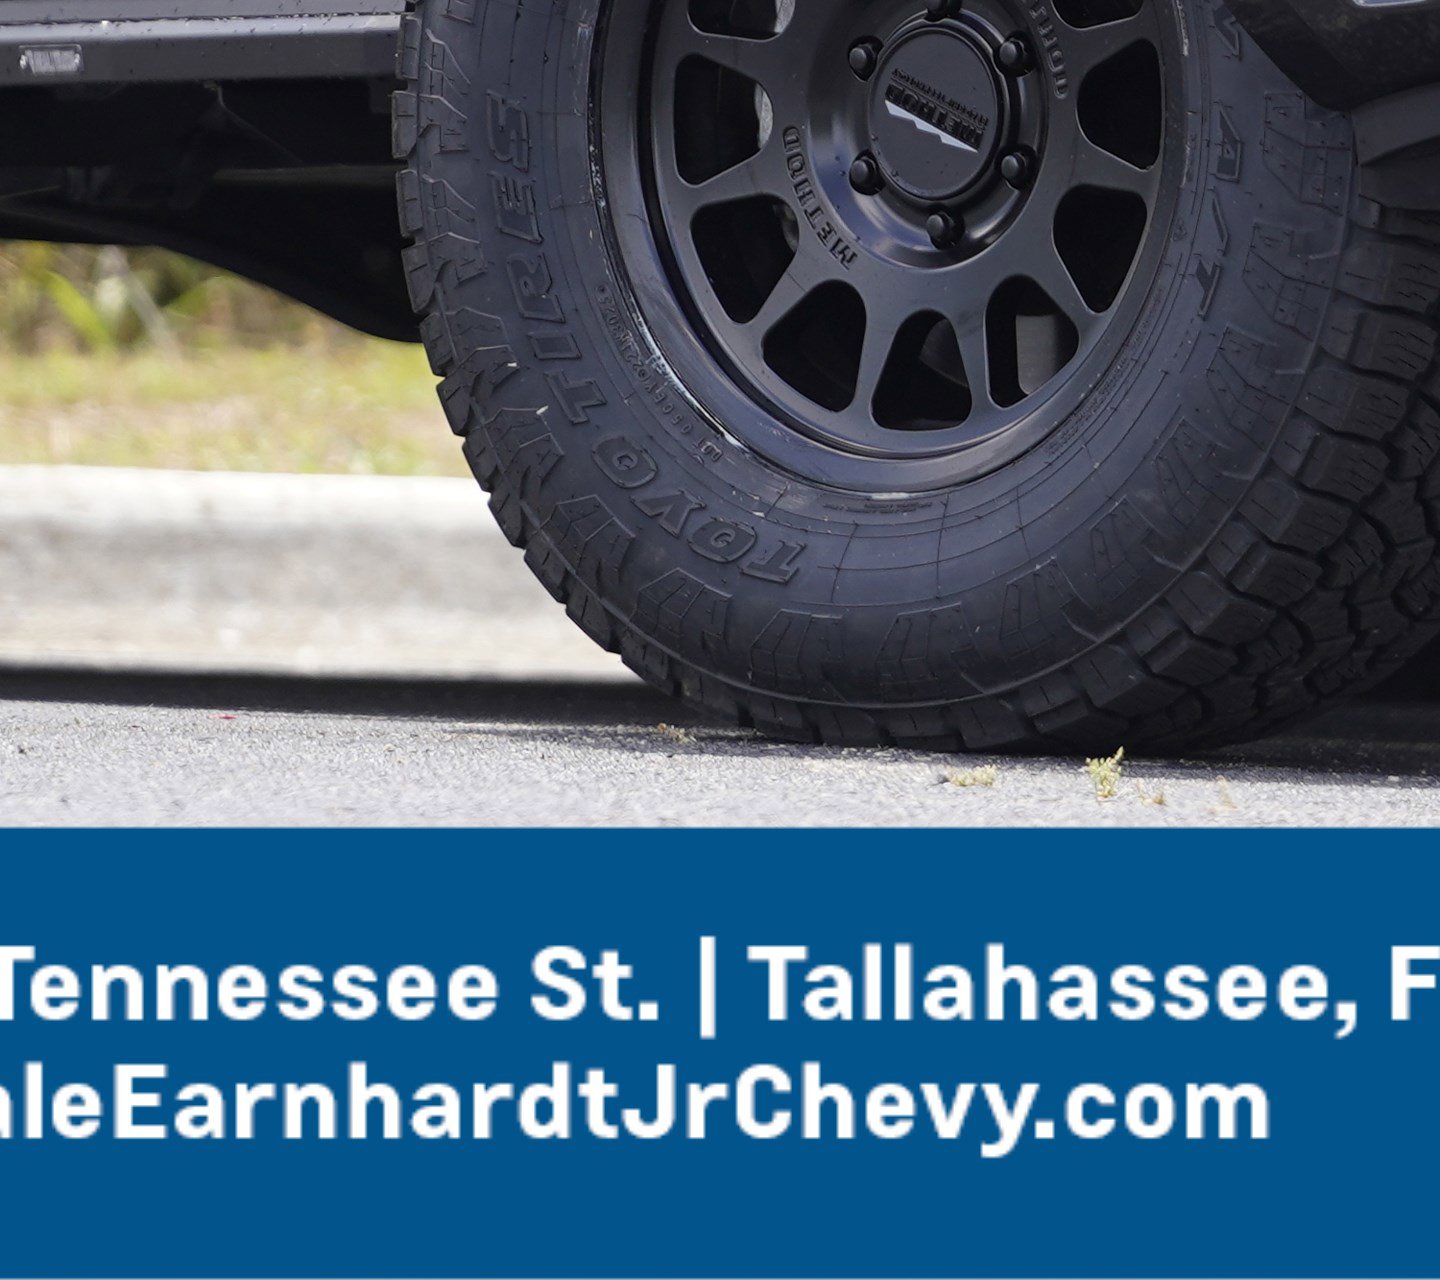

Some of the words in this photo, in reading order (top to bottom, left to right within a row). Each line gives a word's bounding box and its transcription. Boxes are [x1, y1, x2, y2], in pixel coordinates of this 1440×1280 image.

[484, 87, 609, 426] TIRES
[781, 126, 859, 271] METHOD
[590, 436, 808, 585] TOYO
